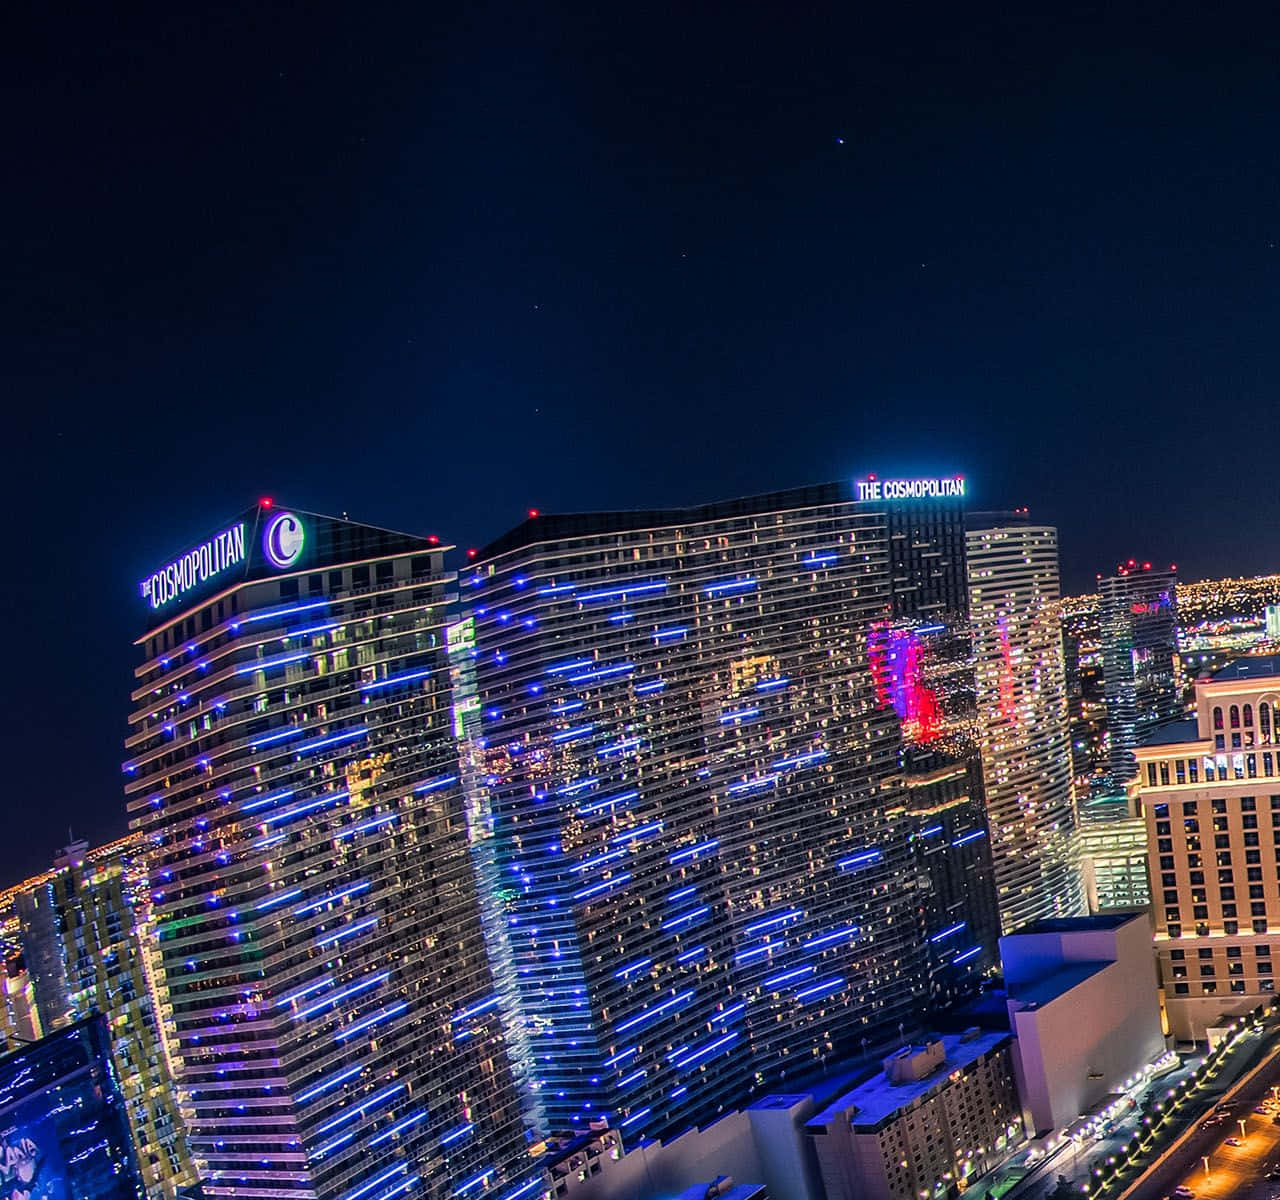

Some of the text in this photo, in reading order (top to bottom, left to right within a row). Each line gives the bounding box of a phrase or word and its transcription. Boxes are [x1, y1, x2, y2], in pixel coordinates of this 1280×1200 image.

[858, 480, 965, 500] THE COSMOPOLITAN
[141, 523, 245, 609] THE COSMOPOLITAN
